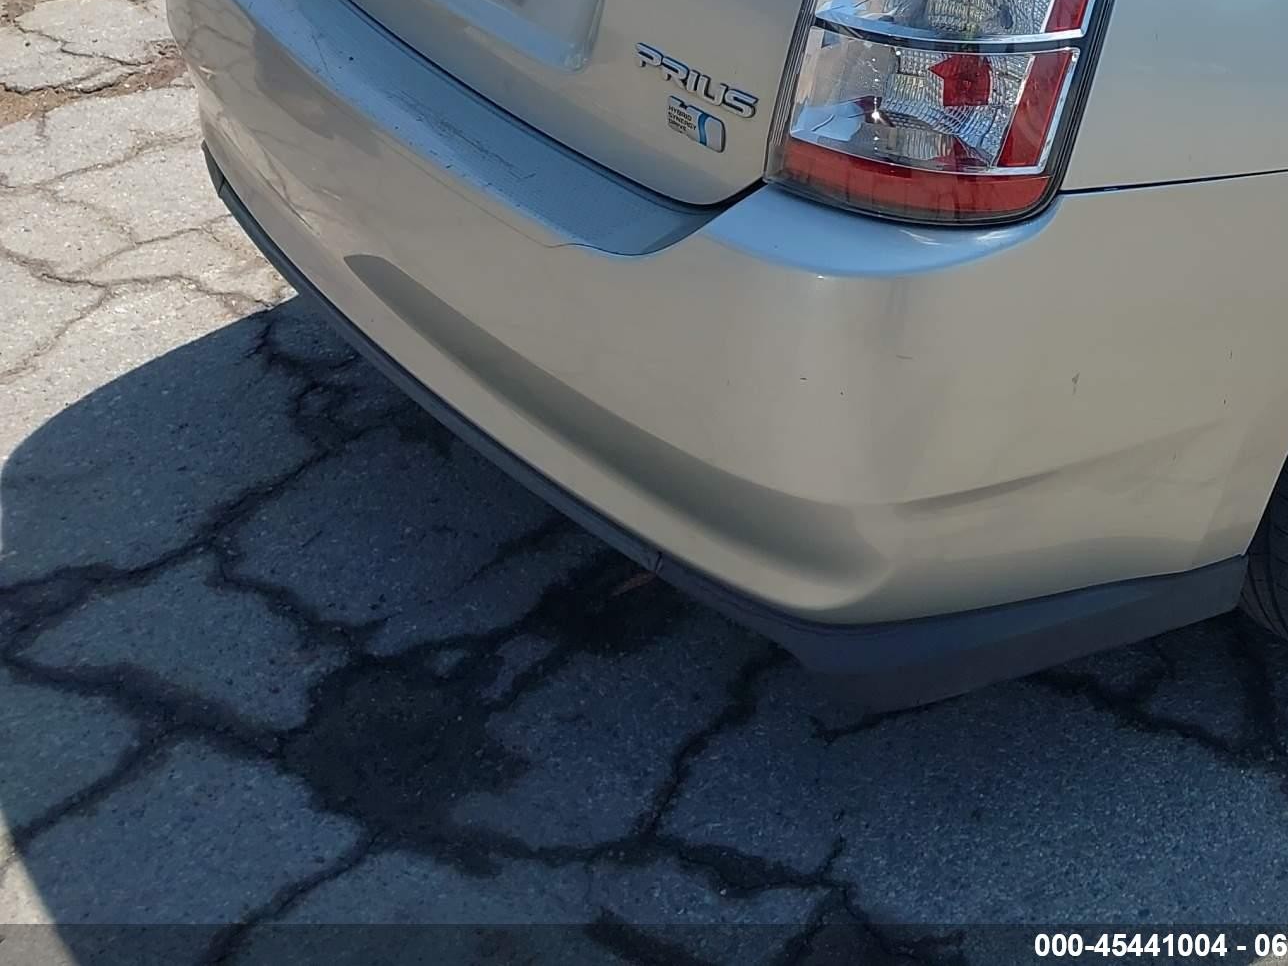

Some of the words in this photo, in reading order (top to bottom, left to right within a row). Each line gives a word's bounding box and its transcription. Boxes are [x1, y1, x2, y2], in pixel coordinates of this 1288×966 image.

[635, 42, 759, 119] PRIUS
[668, 105, 692, 122] HYBRID
[668, 111, 697, 131] SYNERGY
